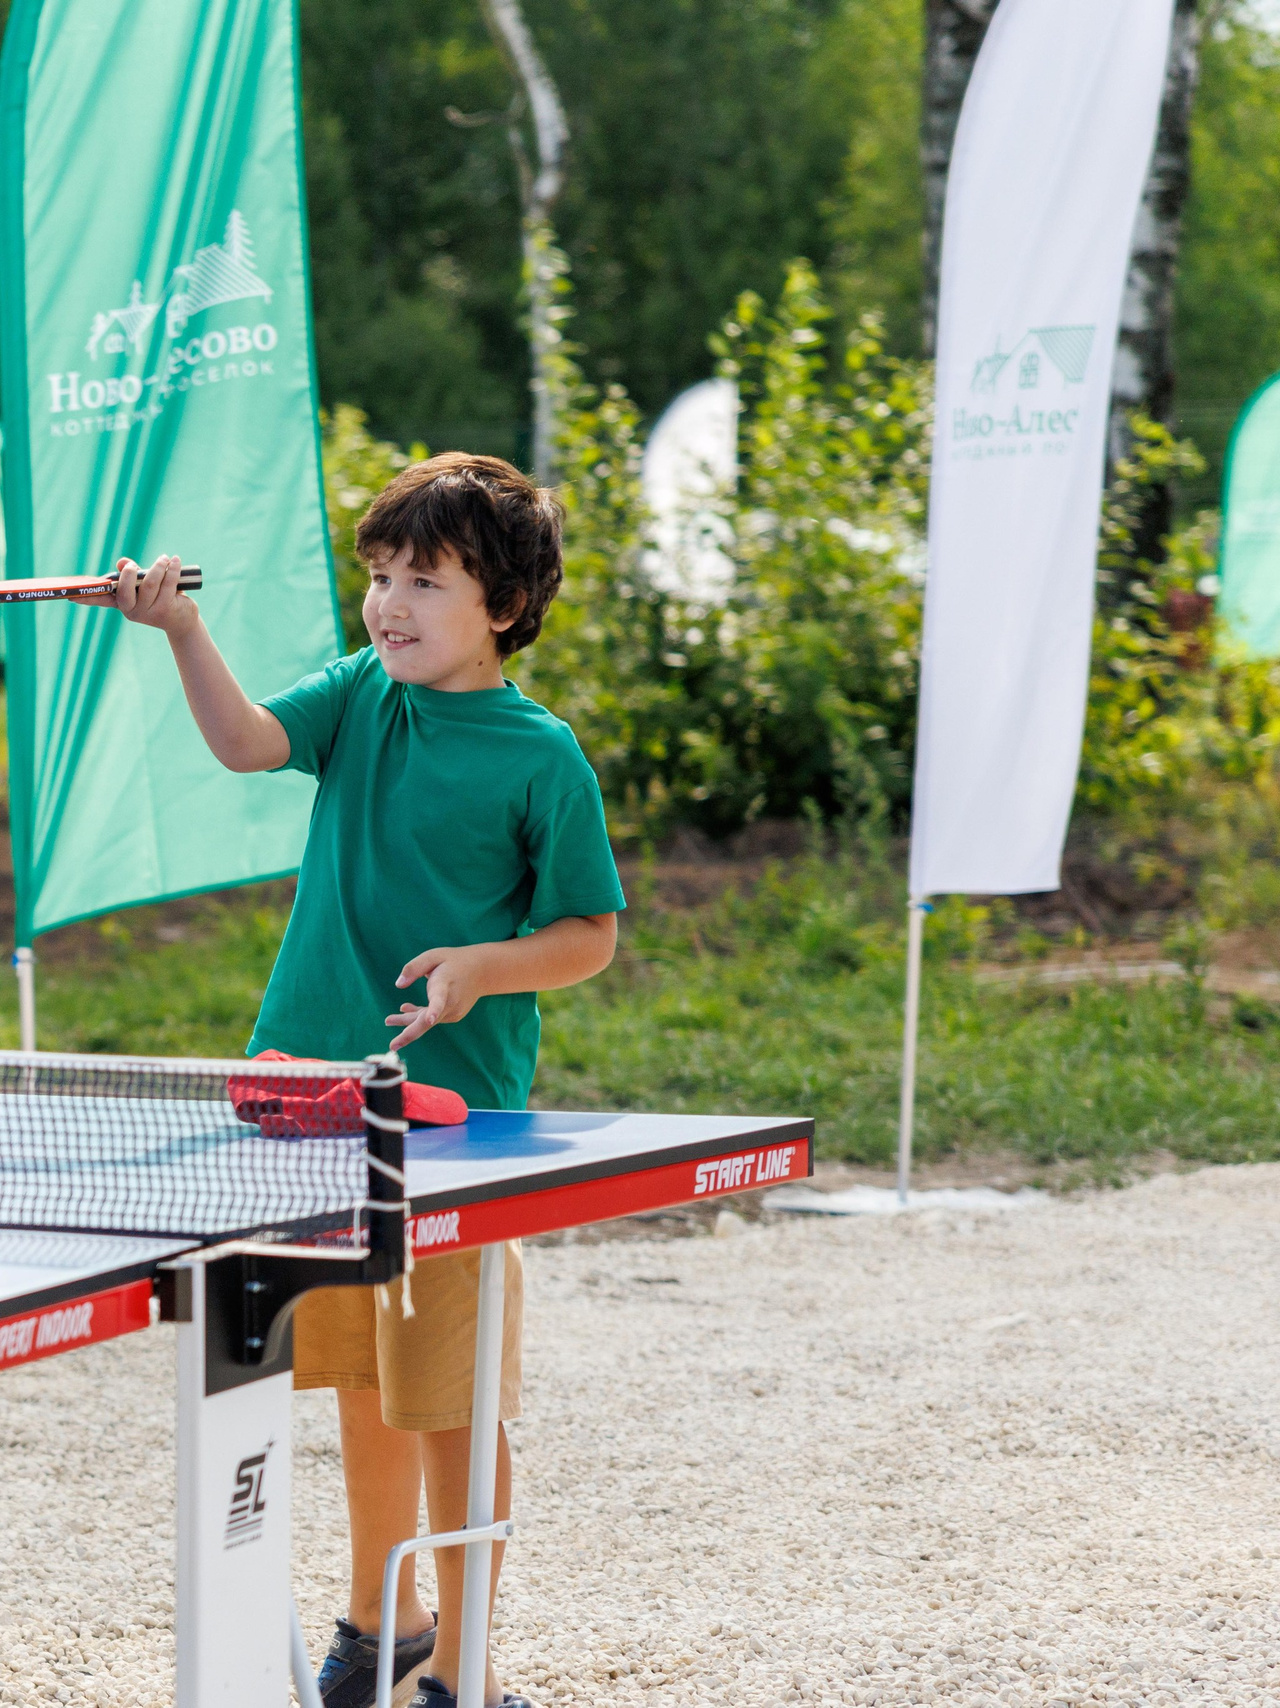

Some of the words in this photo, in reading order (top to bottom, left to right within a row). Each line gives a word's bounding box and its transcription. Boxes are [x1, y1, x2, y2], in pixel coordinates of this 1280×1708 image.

[694, 1153, 756, 1195] START
[415, 1210, 460, 1249] INDOOR
[36, 1301, 94, 1349] INDOOR
